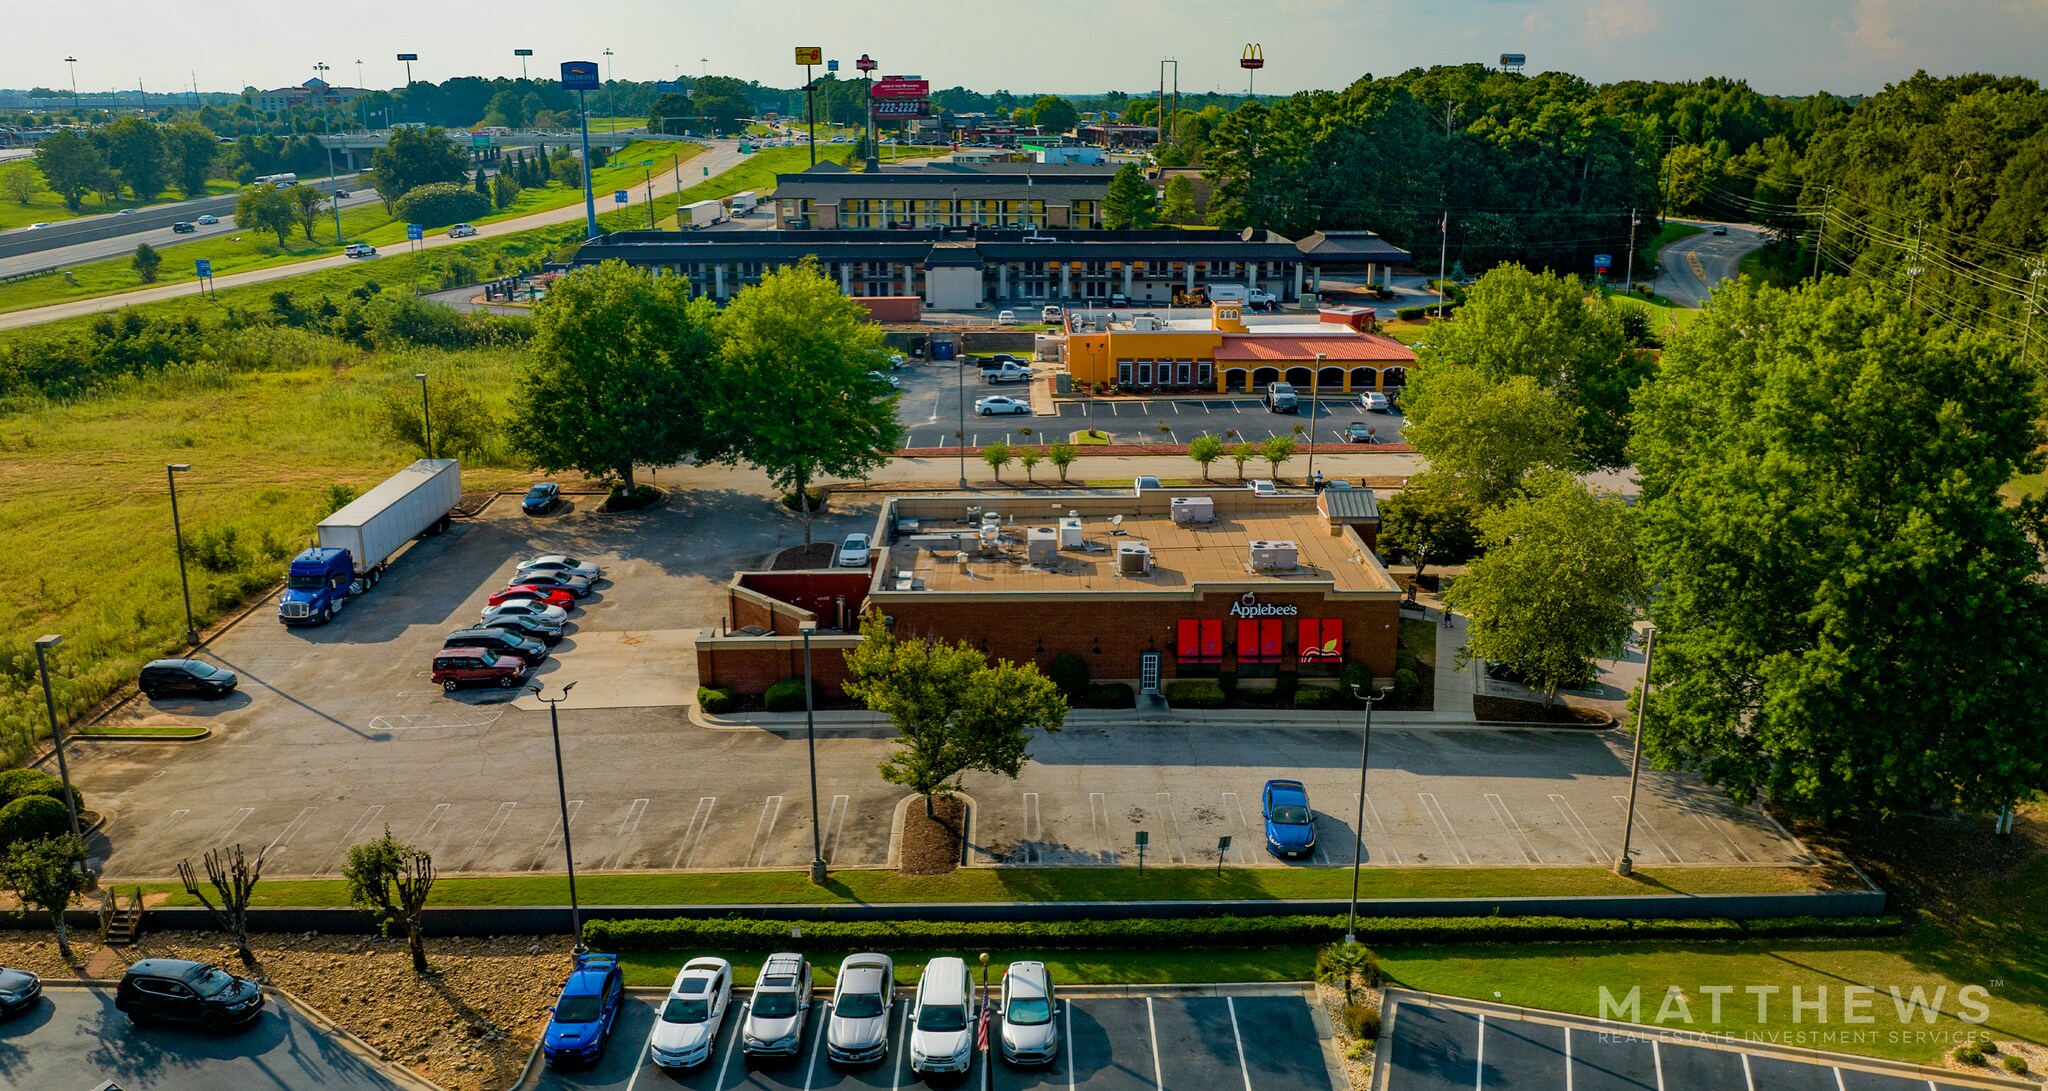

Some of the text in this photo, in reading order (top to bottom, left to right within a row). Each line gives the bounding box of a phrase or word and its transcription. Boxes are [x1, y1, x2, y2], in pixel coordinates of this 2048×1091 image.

[811, 50, 819, 60] 8
[879, 102, 919, 113] 222-2222
[1229, 601, 1298, 618] Applebee's
